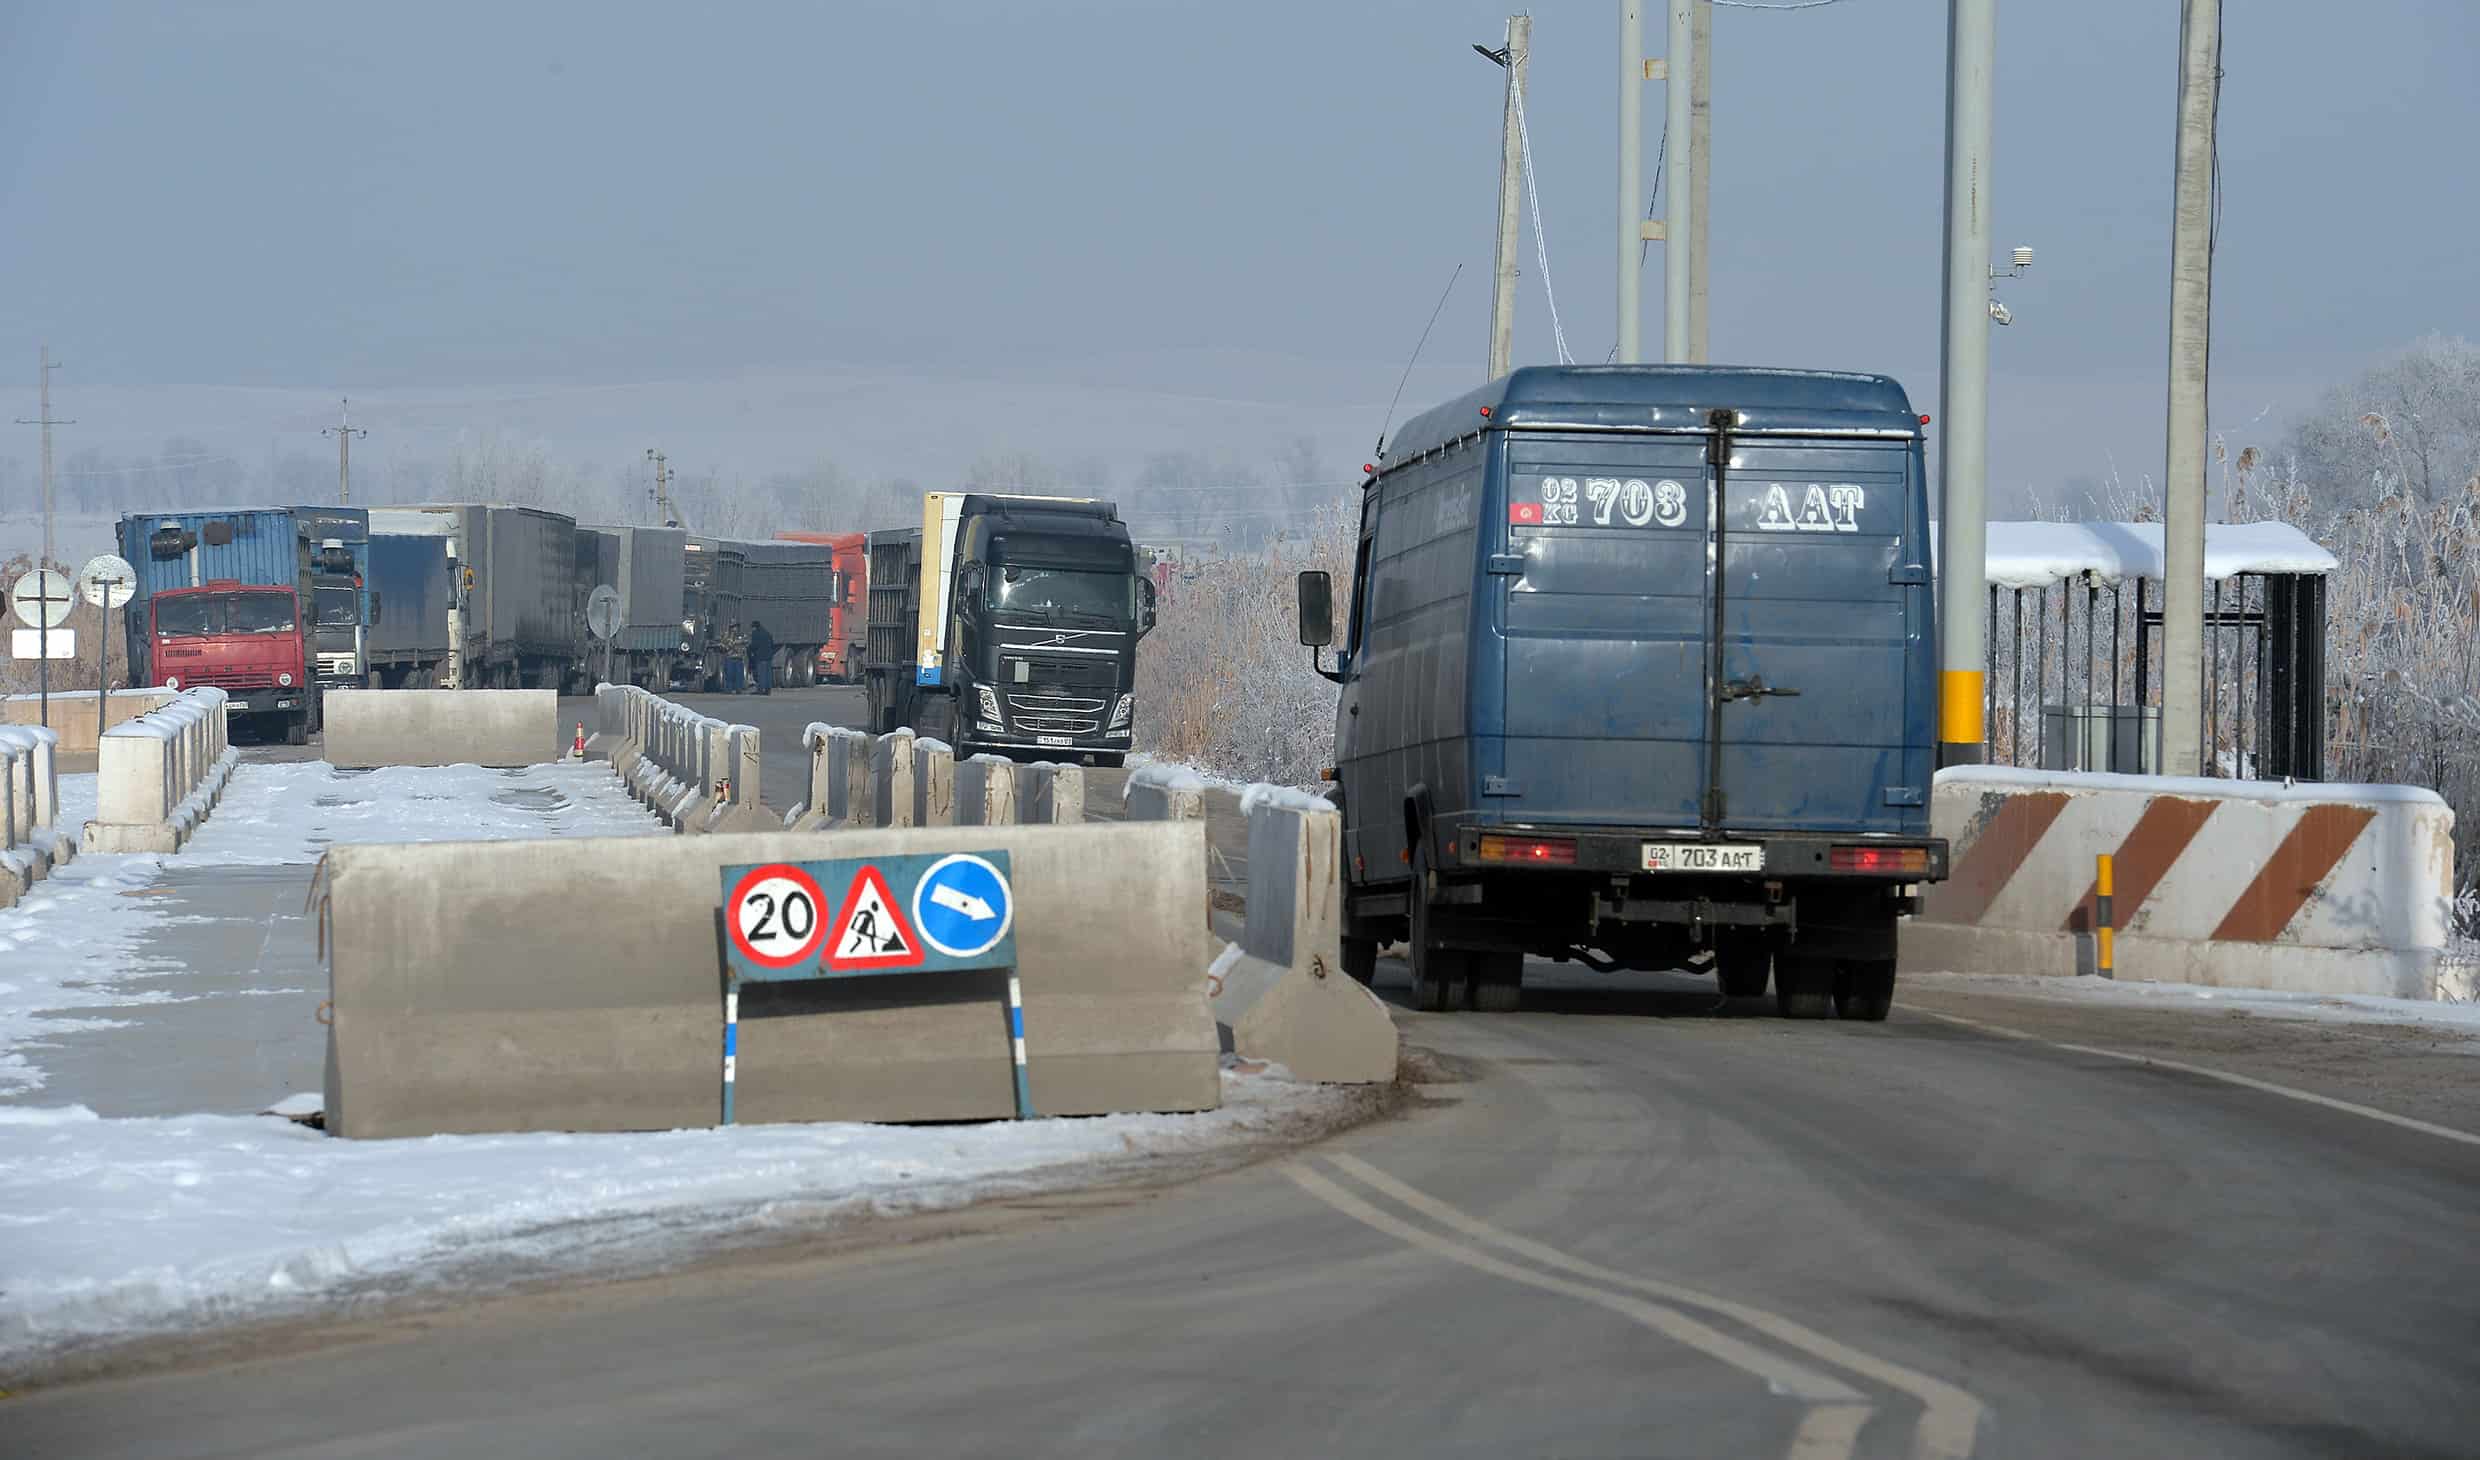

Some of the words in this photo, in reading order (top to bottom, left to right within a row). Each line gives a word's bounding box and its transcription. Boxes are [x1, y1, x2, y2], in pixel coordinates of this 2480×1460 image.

[1541, 478, 1578, 503] 02
[1586, 478, 1687, 527] 703
[1757, 483, 1865, 532] AAT
[1542, 503, 1578, 524] KG
[1681, 848, 1718, 868] 703
[746, 891, 815, 941] 20
